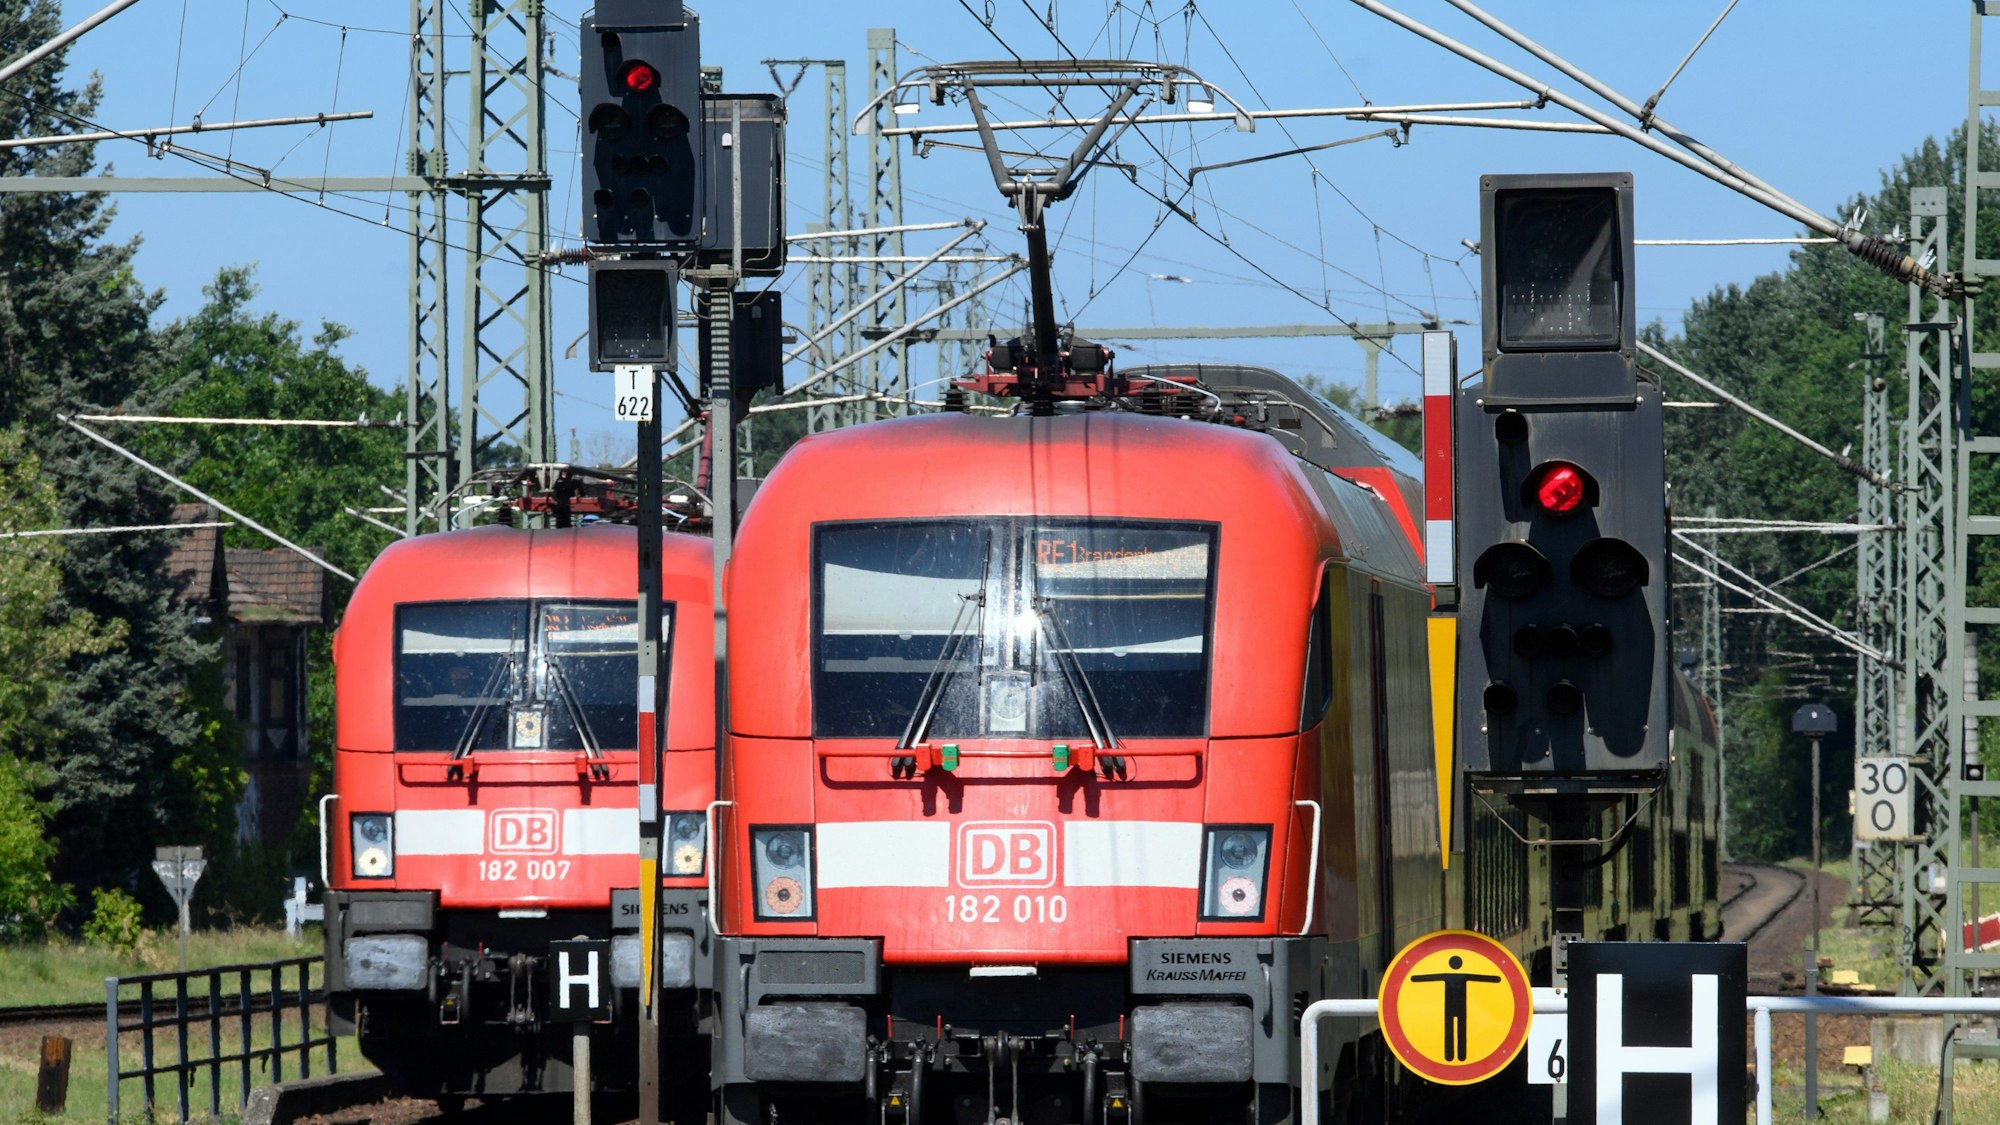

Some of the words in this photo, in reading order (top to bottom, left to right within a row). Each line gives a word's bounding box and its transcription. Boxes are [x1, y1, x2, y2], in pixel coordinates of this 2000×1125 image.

[629, 370, 639, 390] T
[618, 396, 649, 416] 622
[1037, 539, 1077, 573] RE1
[1860, 763, 1907, 795] 30
[1871, 800, 1896, 831] 0
[499, 818, 548, 844] DB
[971, 833, 1042, 876] DB
[478, 860, 517, 881] 182
[526, 859, 571, 881] 007
[944, 894, 1000, 924] 182
[1013, 894, 1067, 924] 010
[1161, 952, 1232, 965] SIEMENS
[558, 951, 599, 1009] H
[1596, 974, 1719, 1125] H
